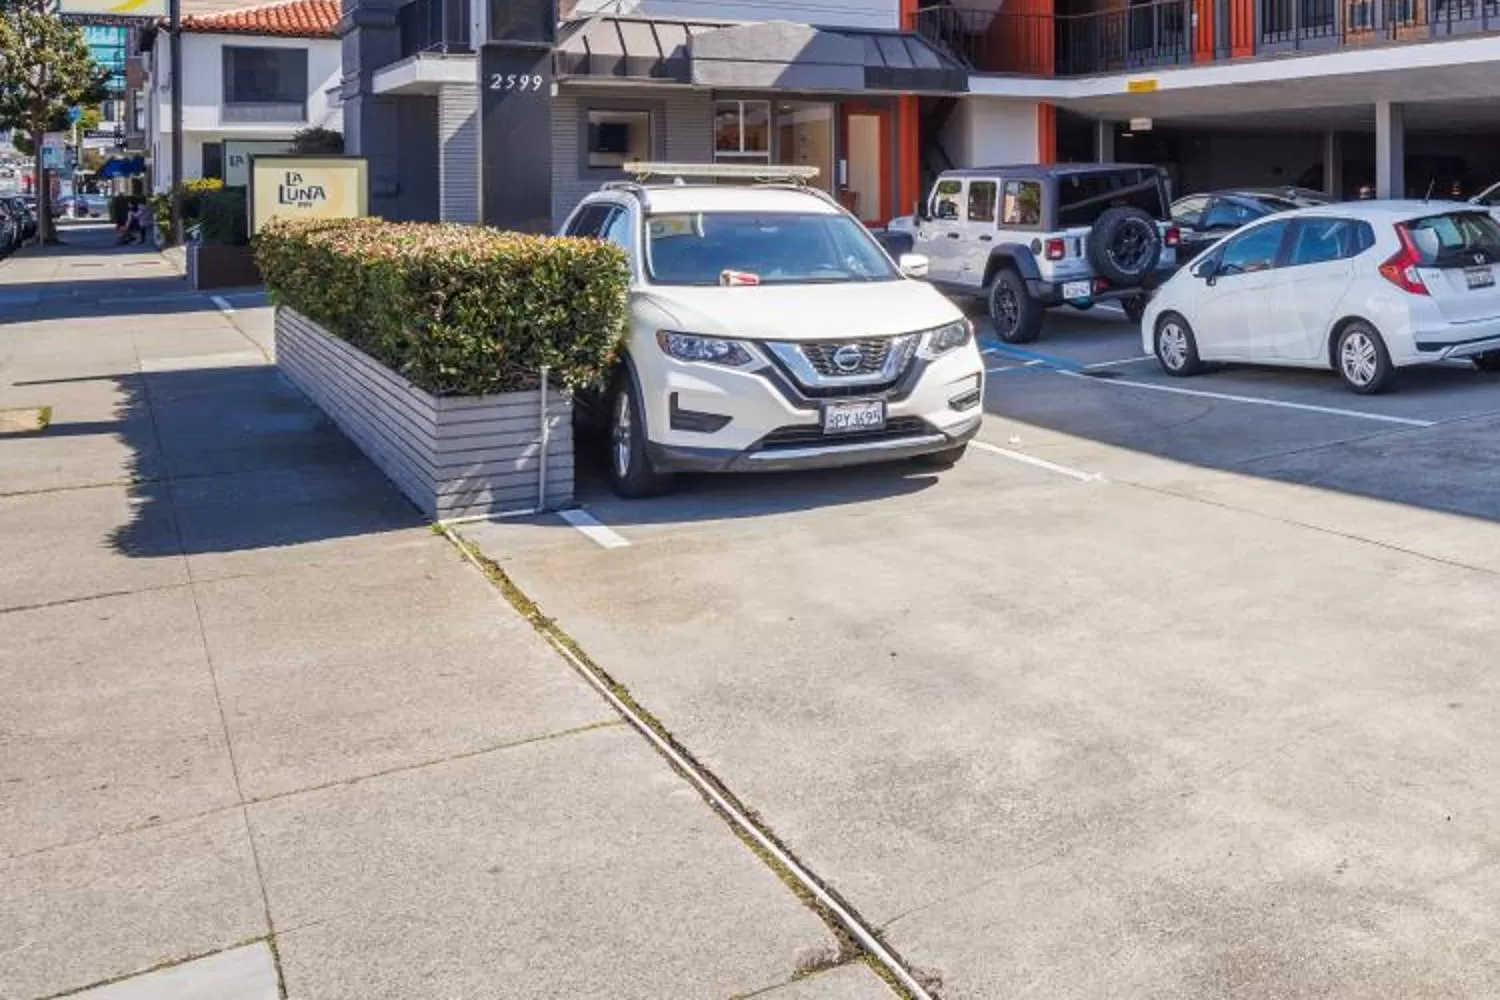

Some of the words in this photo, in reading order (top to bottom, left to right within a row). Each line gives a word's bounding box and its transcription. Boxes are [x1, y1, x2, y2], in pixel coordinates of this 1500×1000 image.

[489, 72, 543, 92] 2599
[286, 171, 303, 187] LA
[278, 183, 327, 205] LUNA
